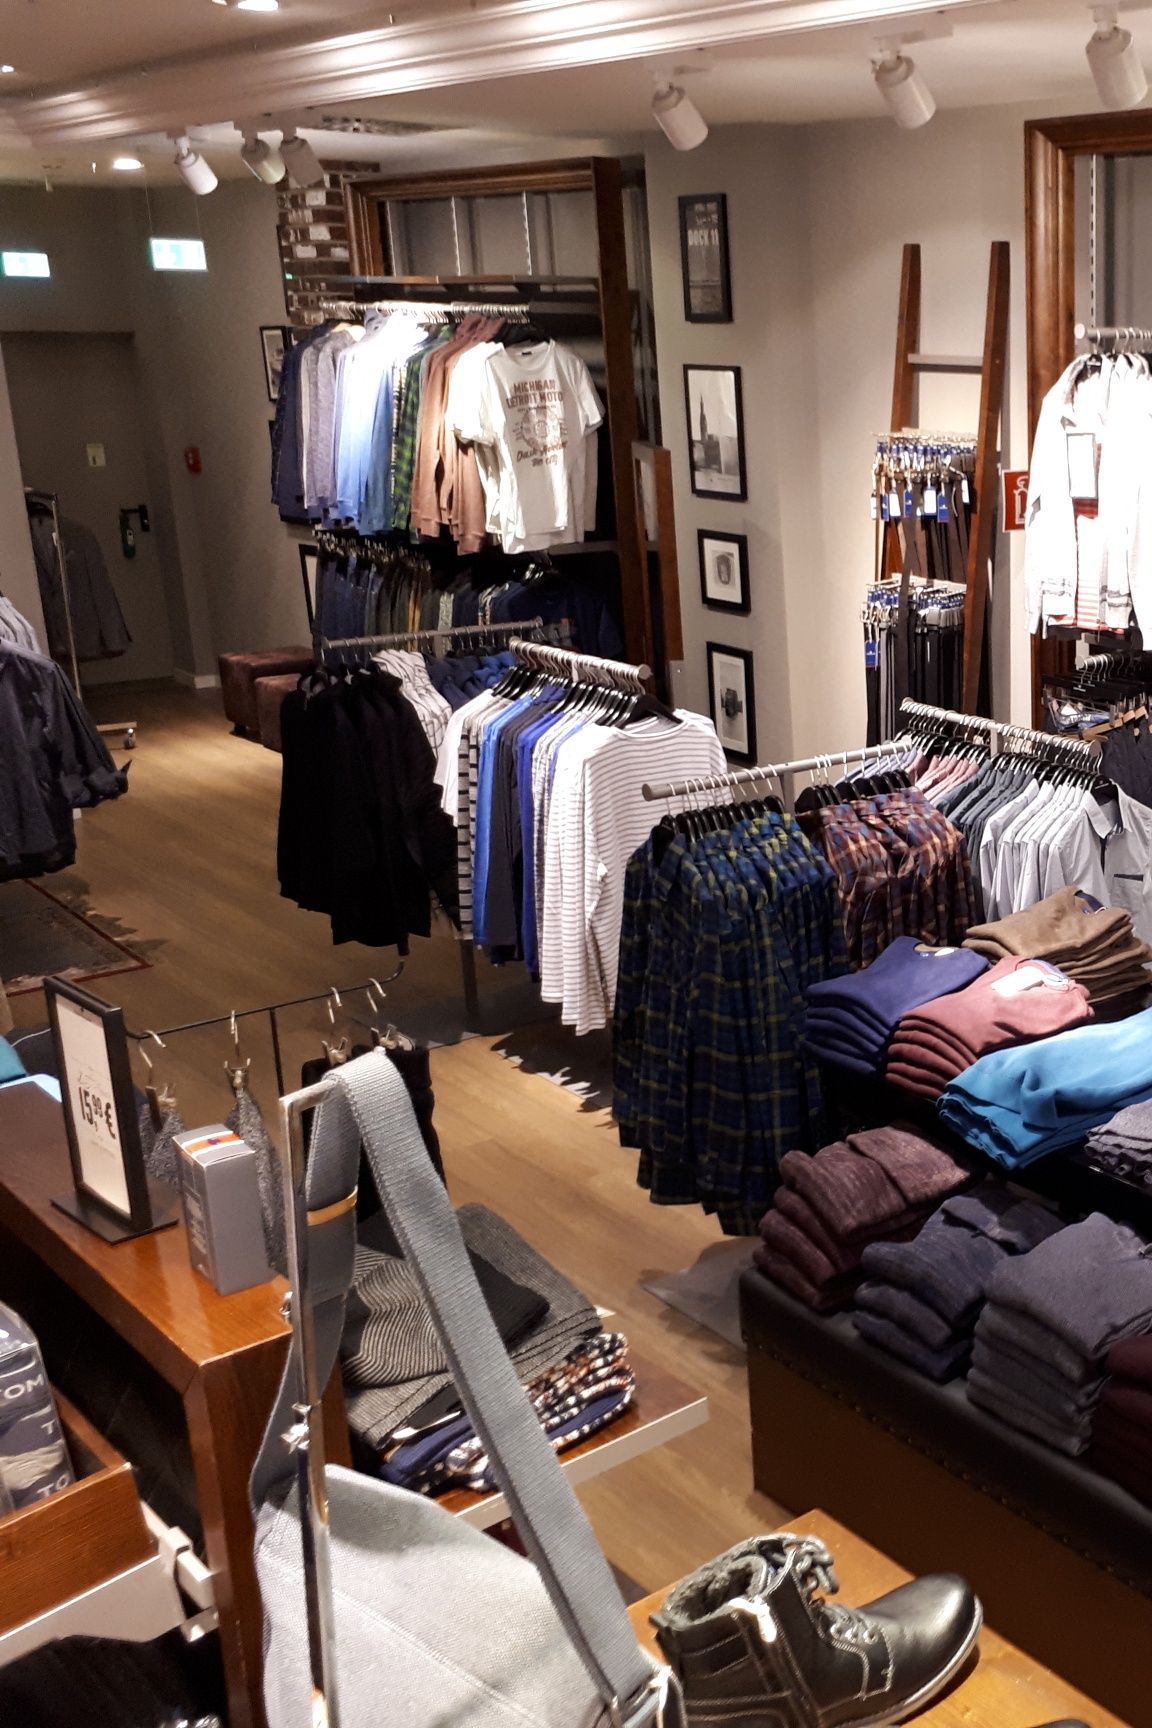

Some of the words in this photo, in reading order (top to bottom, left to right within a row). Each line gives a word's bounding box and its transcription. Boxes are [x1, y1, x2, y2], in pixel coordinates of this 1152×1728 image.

[687, 229, 709, 246] DOCK
[513, 379, 557, 395] MICHIGAN
[0, 1372, 45, 1400] OM
